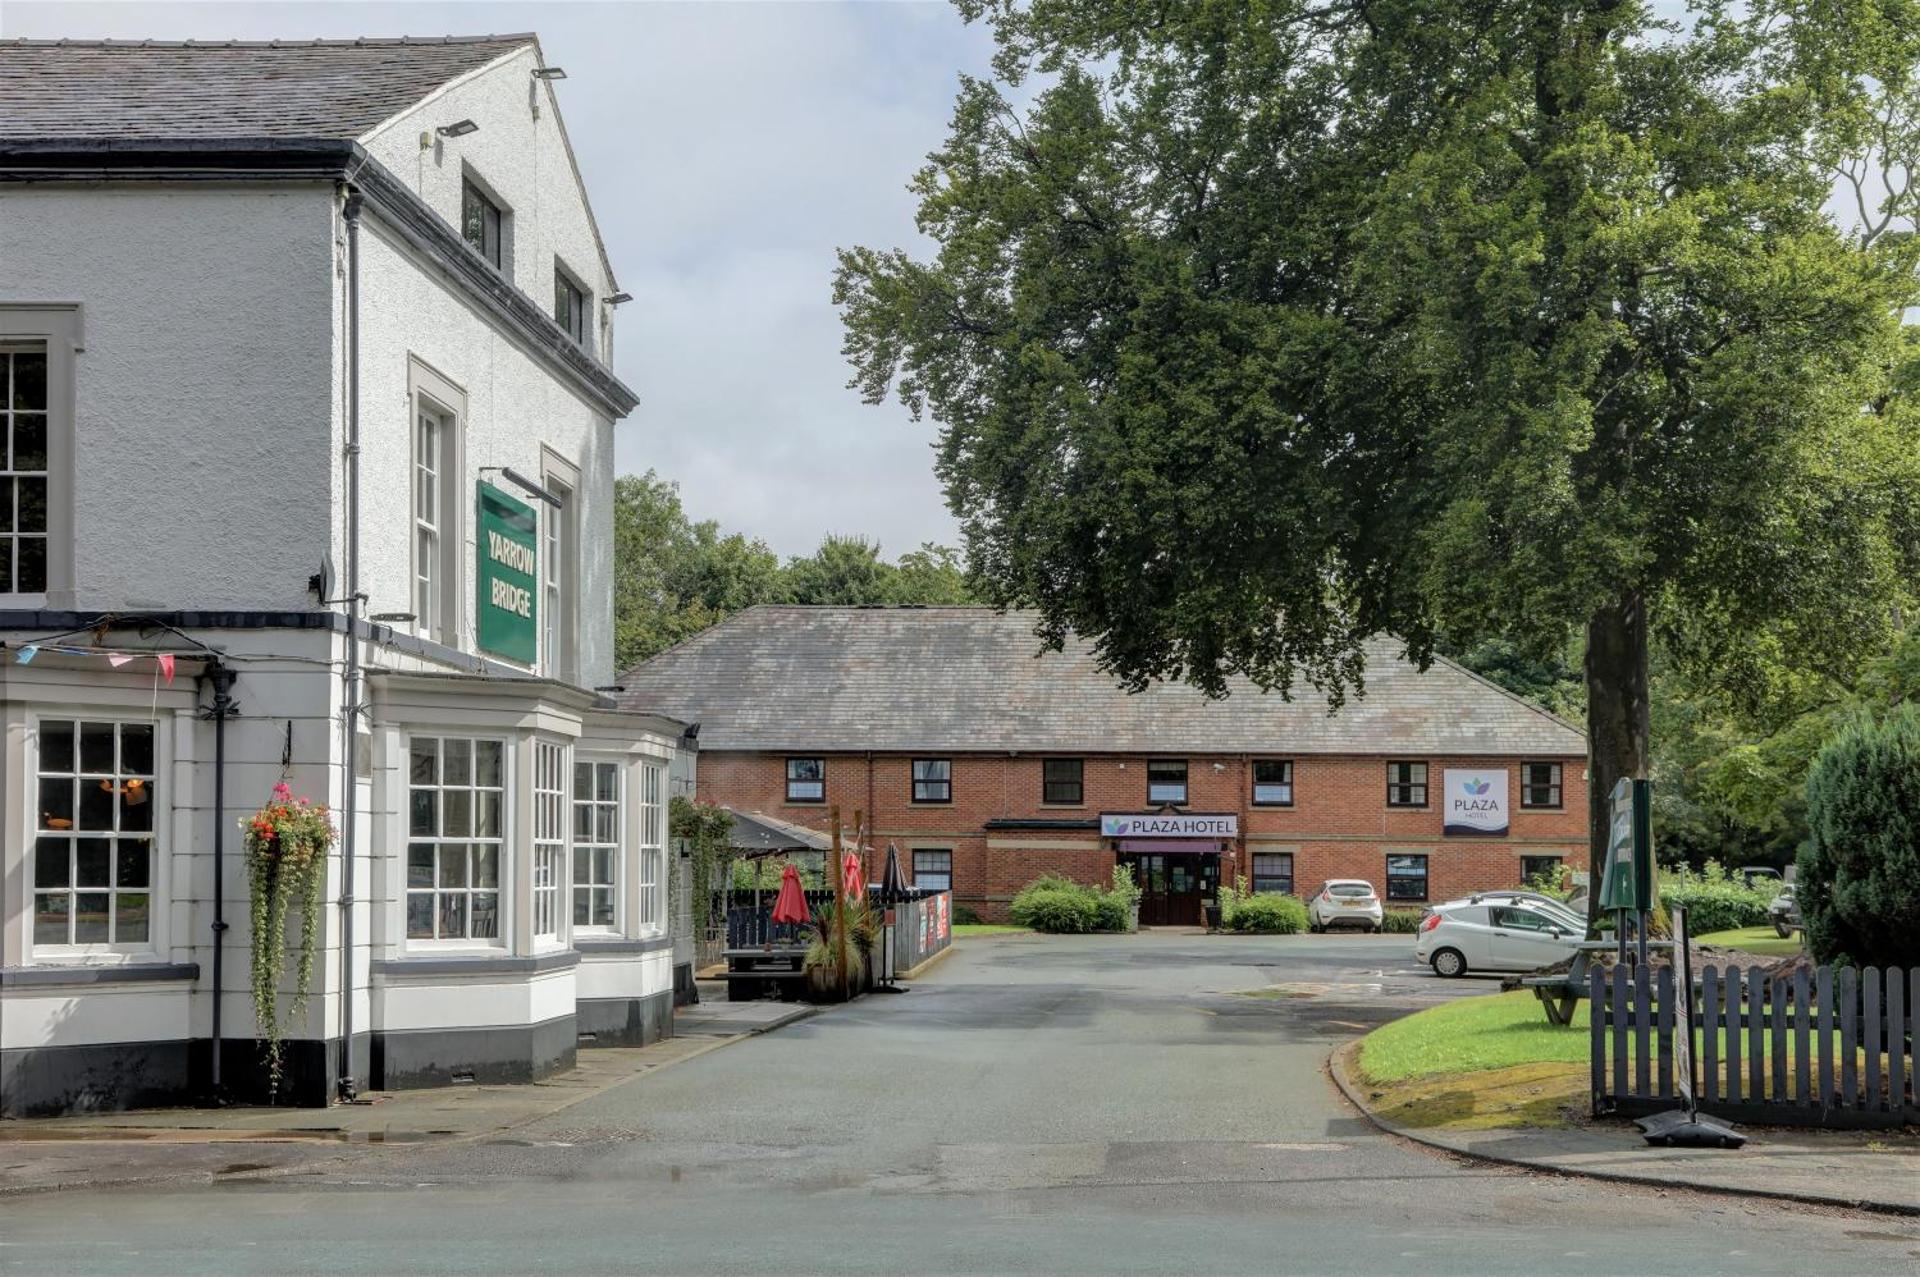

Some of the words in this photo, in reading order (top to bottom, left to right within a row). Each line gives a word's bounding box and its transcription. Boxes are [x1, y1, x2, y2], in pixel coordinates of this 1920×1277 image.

[488, 529, 534, 576] YARROW
[491, 576, 531, 618] BRIDGE
[1454, 799, 1499, 811] PLAZA
[1132, 820, 1181, 833] PLAZA
[1184, 820, 1233, 833] HOTEL
